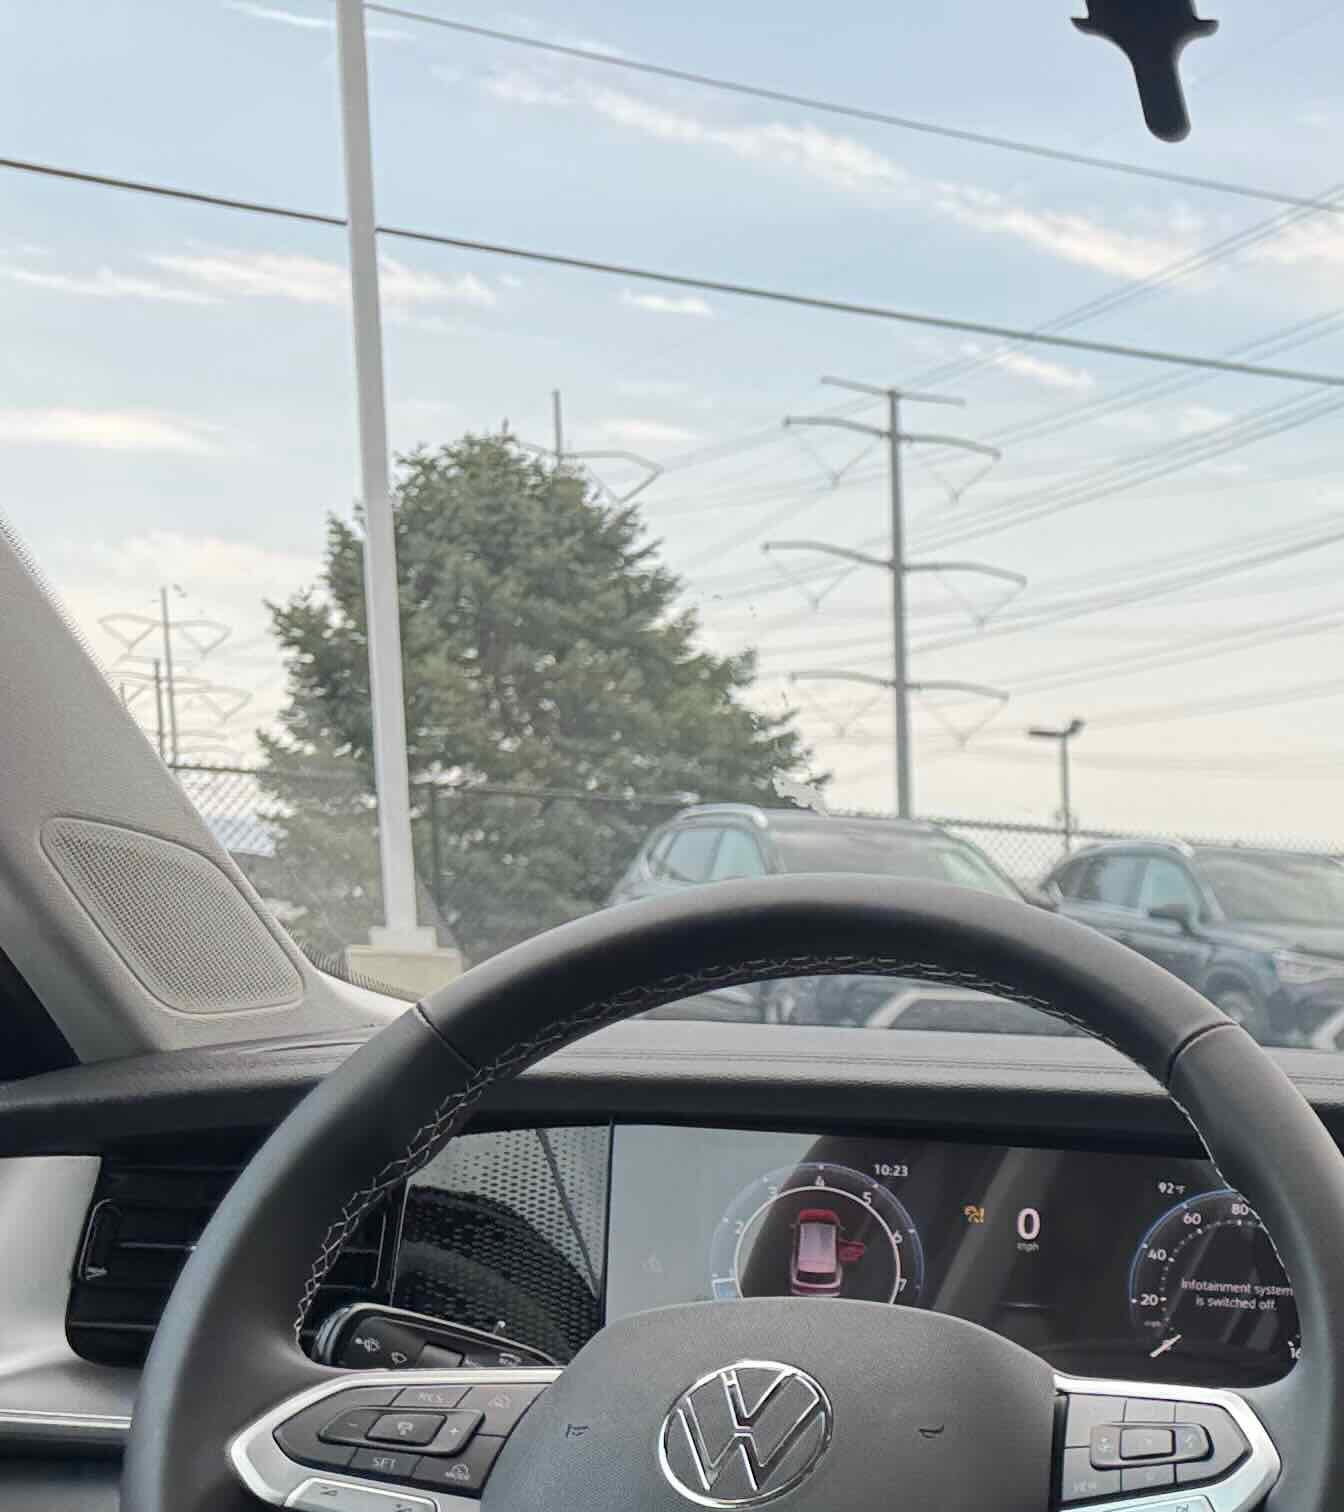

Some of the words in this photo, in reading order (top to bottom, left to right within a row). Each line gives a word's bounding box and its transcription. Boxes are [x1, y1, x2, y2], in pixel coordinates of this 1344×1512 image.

[874, 1164, 908, 1177] 10:23
[1231, 1203, 1249, 1216] 80
[1017, 1207, 1041, 1241] 0
[1183, 1213, 1202, 1225] 60
[1148, 1249, 1167, 1261] 40
[1181, 1277, 1251, 1293] Infotainment
[1254, 1284, 1294, 1297] system
[1140, 1294, 1159, 1306] 20
[1196, 1296, 1205, 1306] is
[1208, 1297, 1256, 1309] switched
